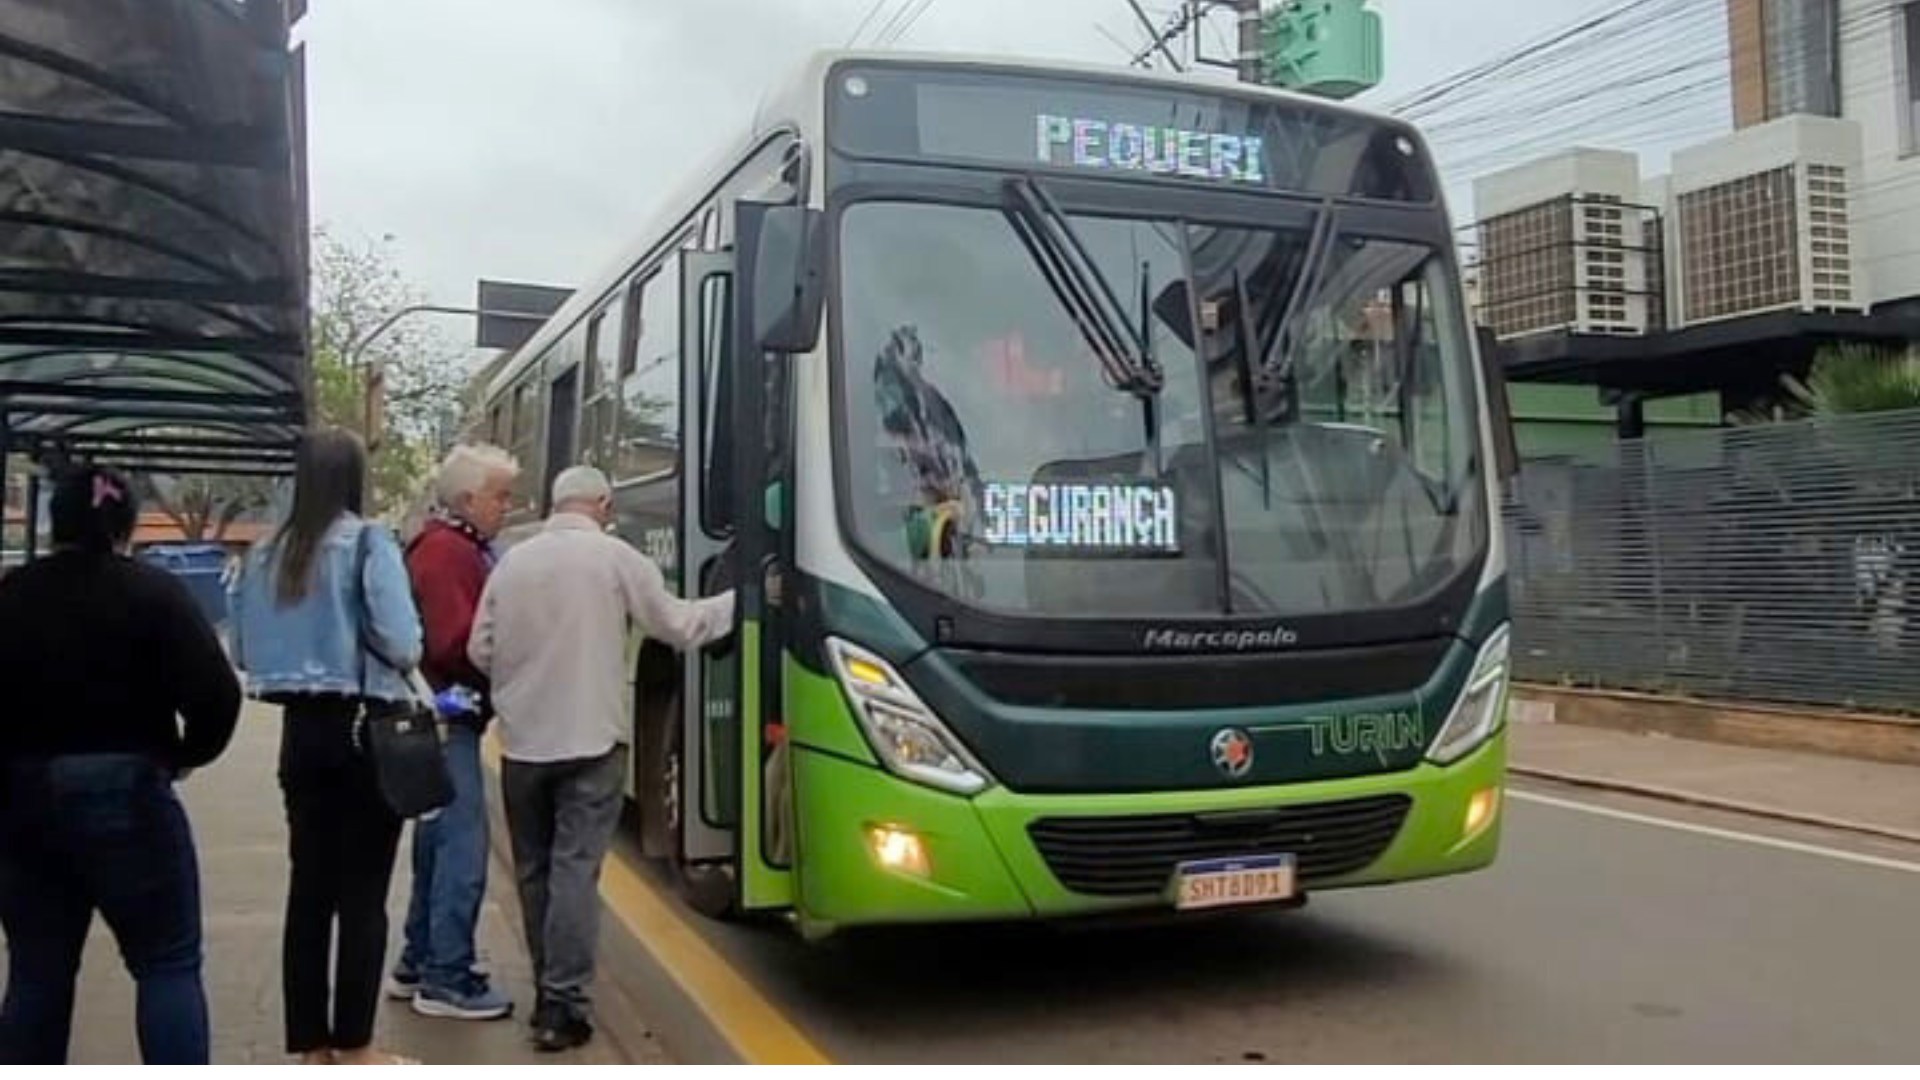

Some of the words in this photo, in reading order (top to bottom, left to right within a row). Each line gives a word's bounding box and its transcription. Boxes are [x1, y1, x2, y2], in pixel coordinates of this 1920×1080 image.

[983, 483, 1176, 546] SEGURANÇA
[1144, 627, 1297, 649] Marcopolo
[1305, 690, 1425, 767] TURIN
